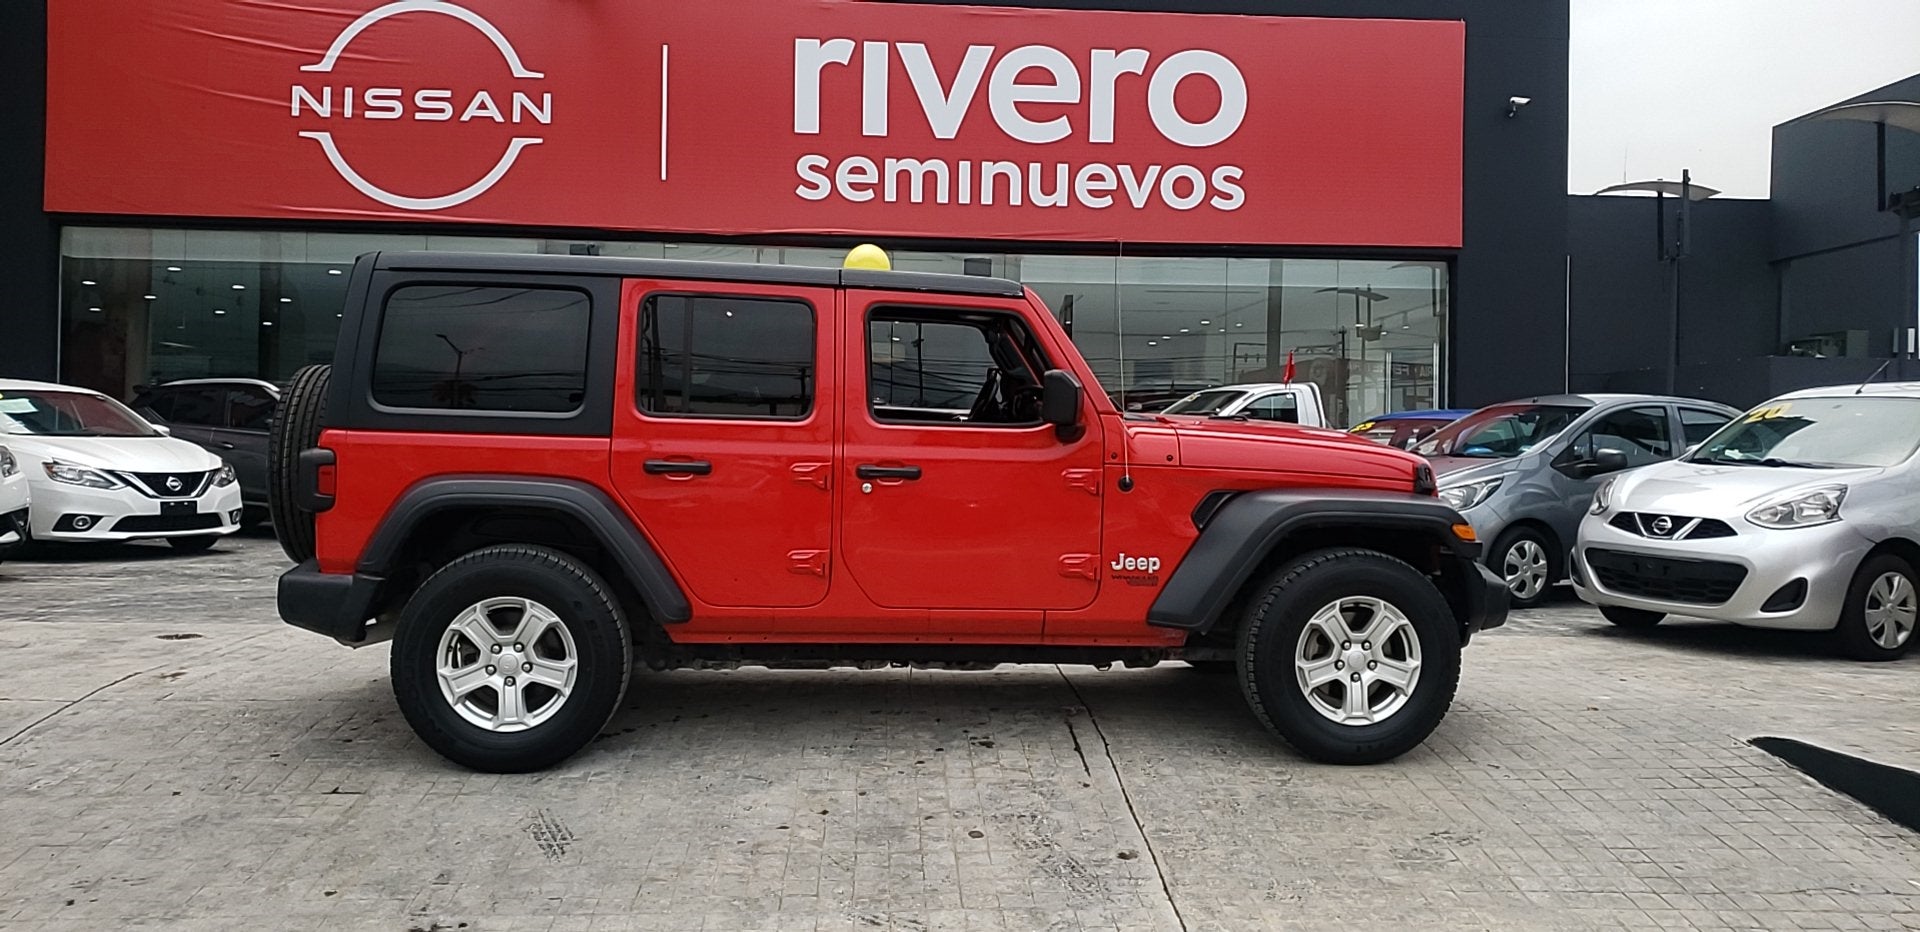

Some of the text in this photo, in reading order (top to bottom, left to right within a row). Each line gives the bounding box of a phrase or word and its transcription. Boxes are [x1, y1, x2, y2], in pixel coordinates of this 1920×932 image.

[292, 86, 551, 123] NISSAN
[795, 39, 1247, 146] rivero
[796, 155, 1244, 210] seminuevos
[1111, 553, 1160, 573] Jeep
